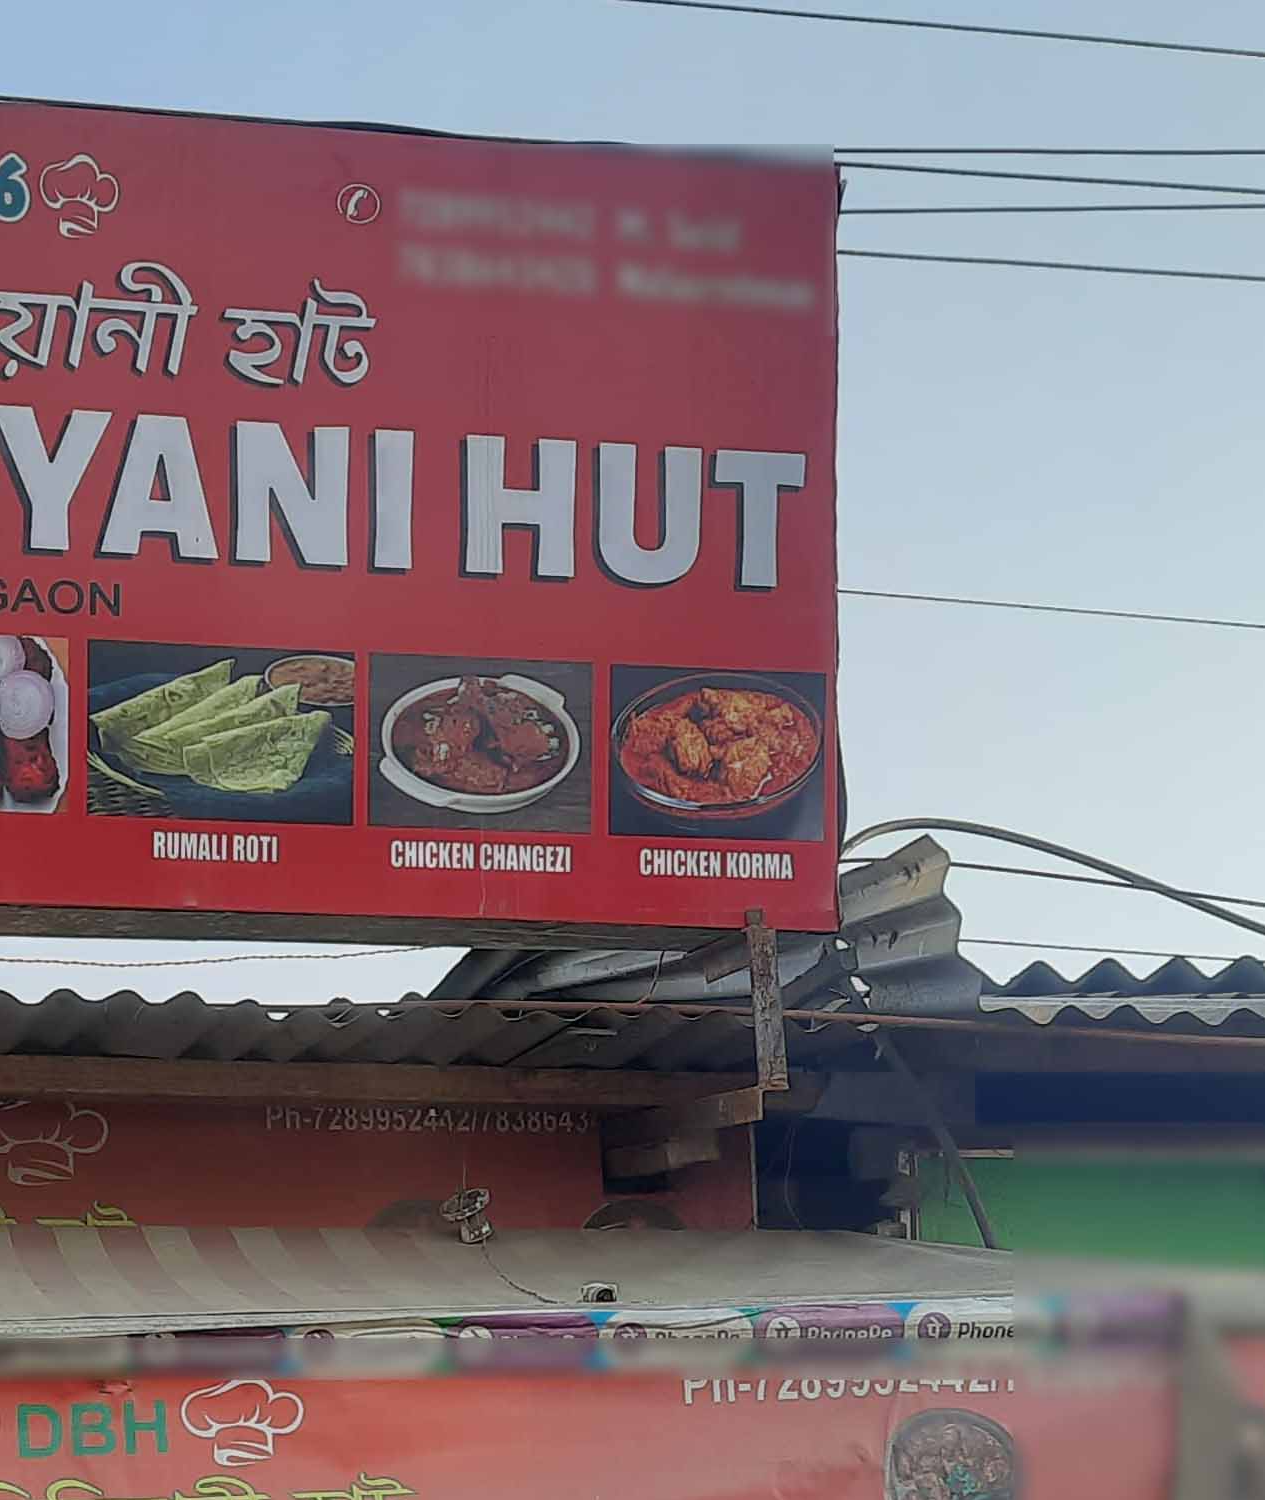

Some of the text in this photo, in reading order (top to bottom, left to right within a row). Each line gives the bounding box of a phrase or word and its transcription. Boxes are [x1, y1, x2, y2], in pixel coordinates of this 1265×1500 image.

[222, 278, 377, 386] হাট
[460, 434, 809, 591] HUT
[152, 830, 279, 863] RUMALI ROTI
[390, 839, 572, 873] CHICKEN CHANGEZI
[638, 848, 793, 881] CHICKEN KORMA
[17, 1400, 169, 1460] DBH
